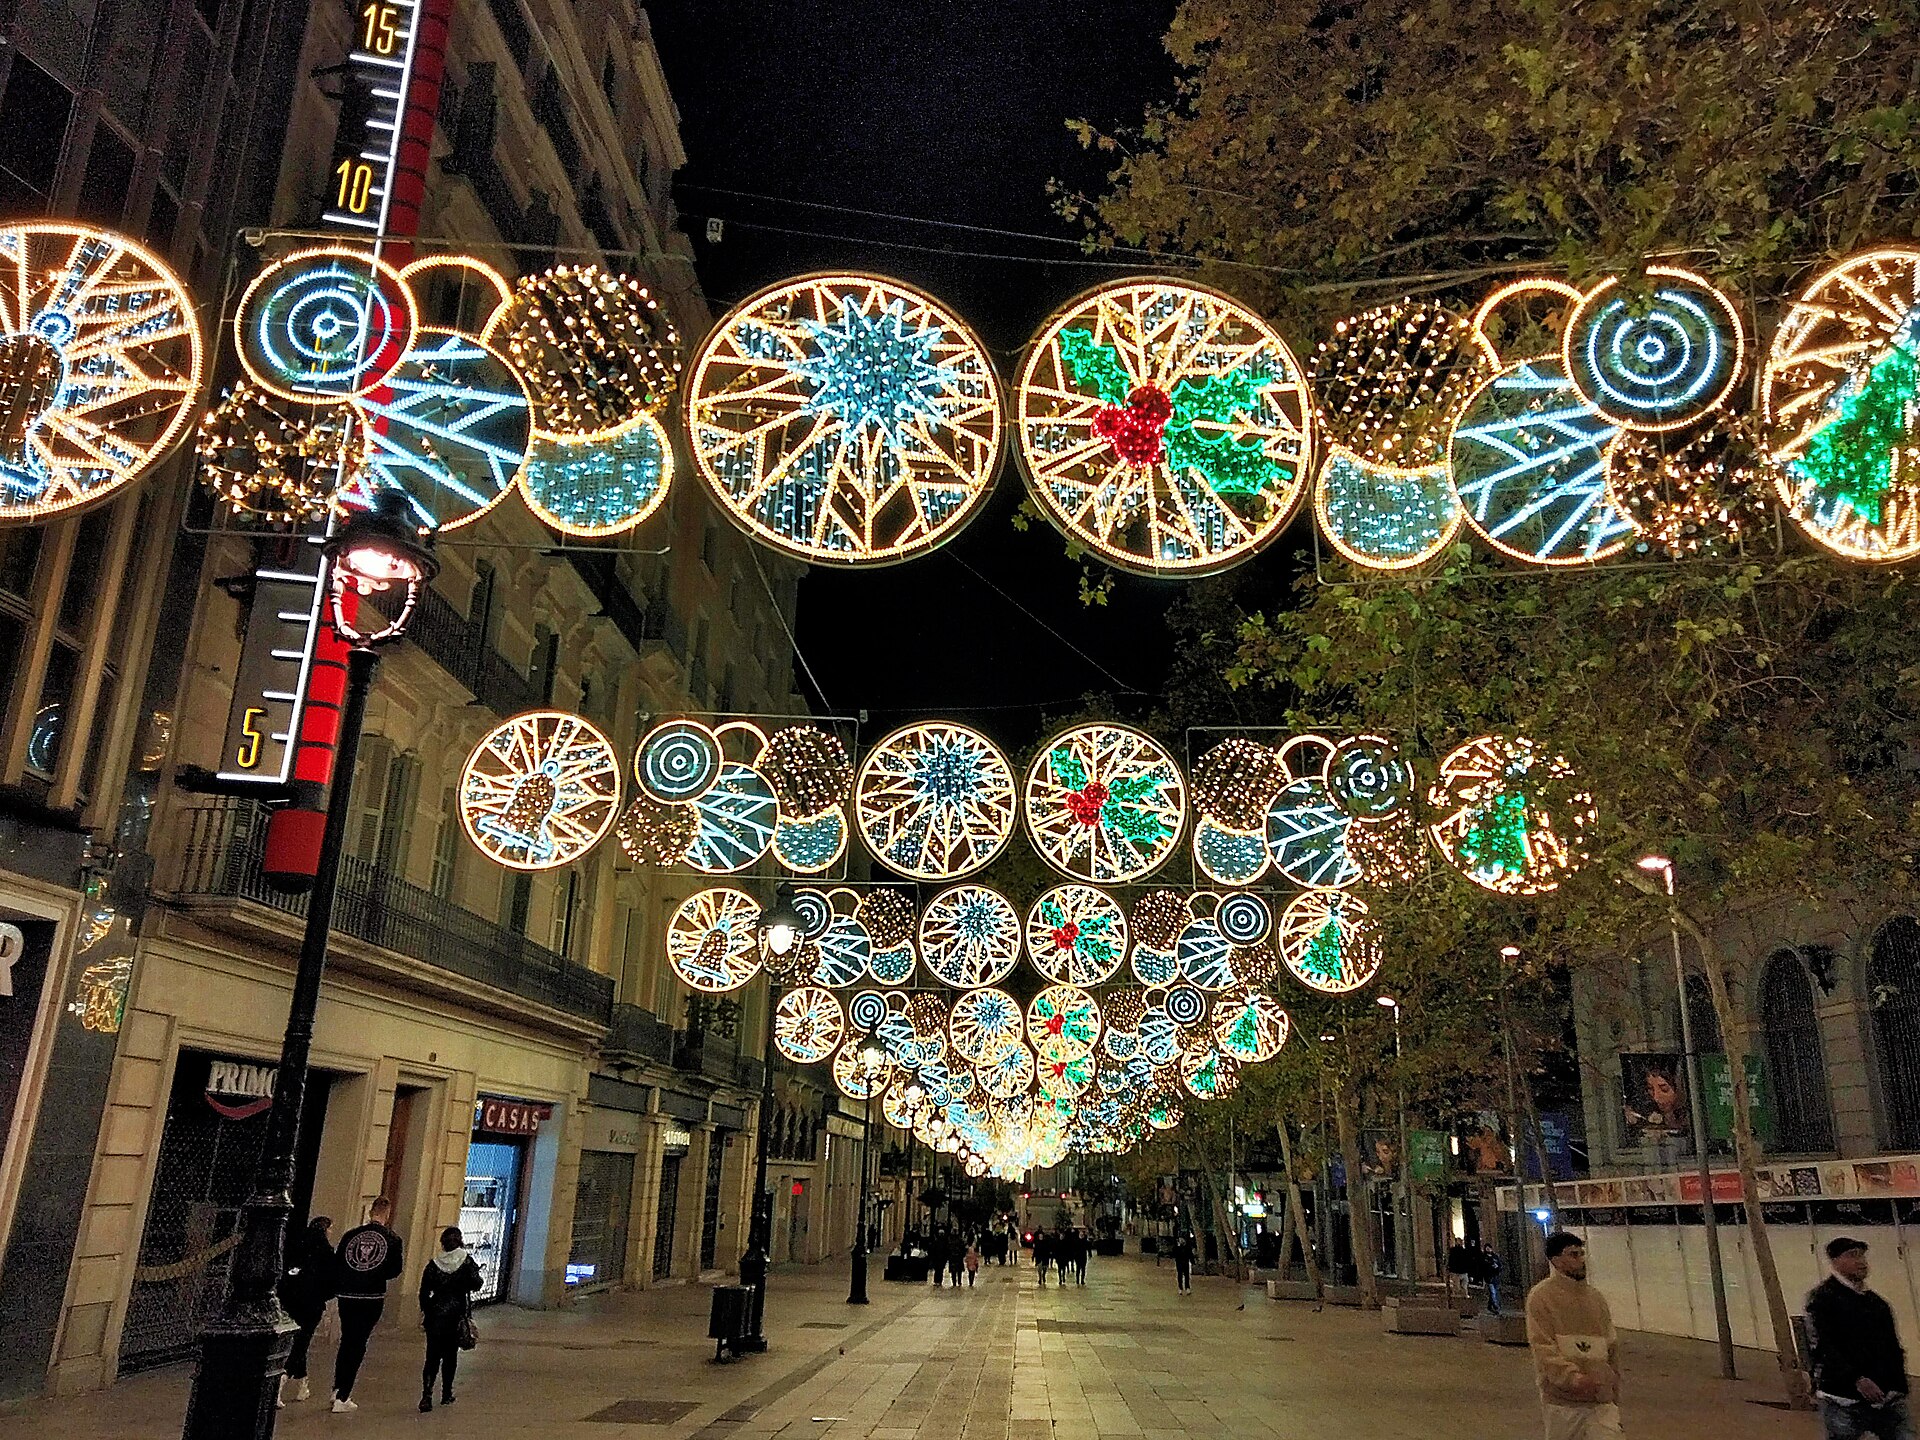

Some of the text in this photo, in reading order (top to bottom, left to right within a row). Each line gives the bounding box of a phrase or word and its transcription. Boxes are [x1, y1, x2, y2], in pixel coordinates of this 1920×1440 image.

[363, 3, 398, 54] 15
[336, 159, 372, 214] 10
[237, 707, 265, 768] 5
[486, 1104, 540, 1131] CASAS
